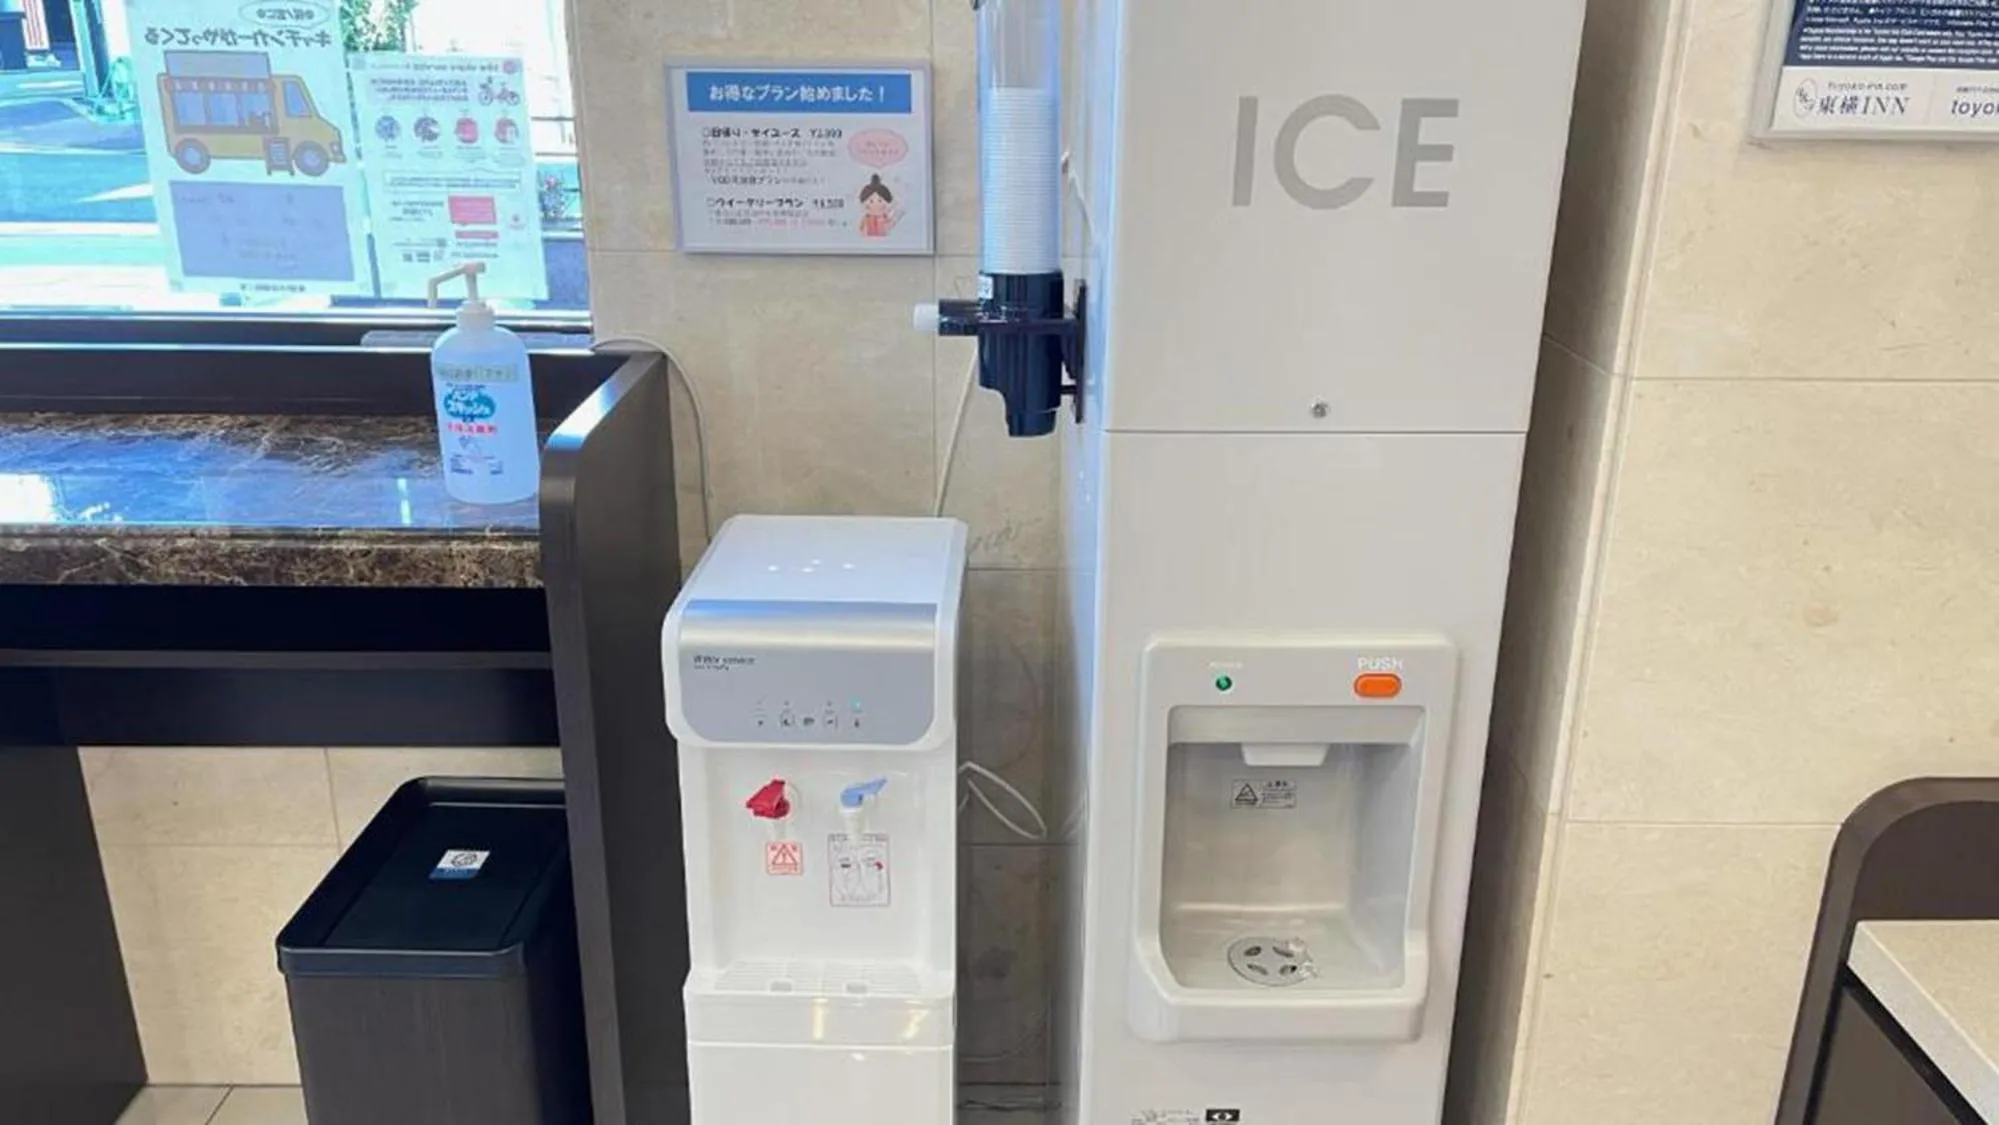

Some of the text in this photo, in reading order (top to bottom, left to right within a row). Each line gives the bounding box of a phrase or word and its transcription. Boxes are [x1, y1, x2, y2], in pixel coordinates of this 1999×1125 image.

[1951, 100, 1999, 117] toyo
[1232, 94, 1459, 210] ICE
[1357, 657, 1403, 670] PUSH
